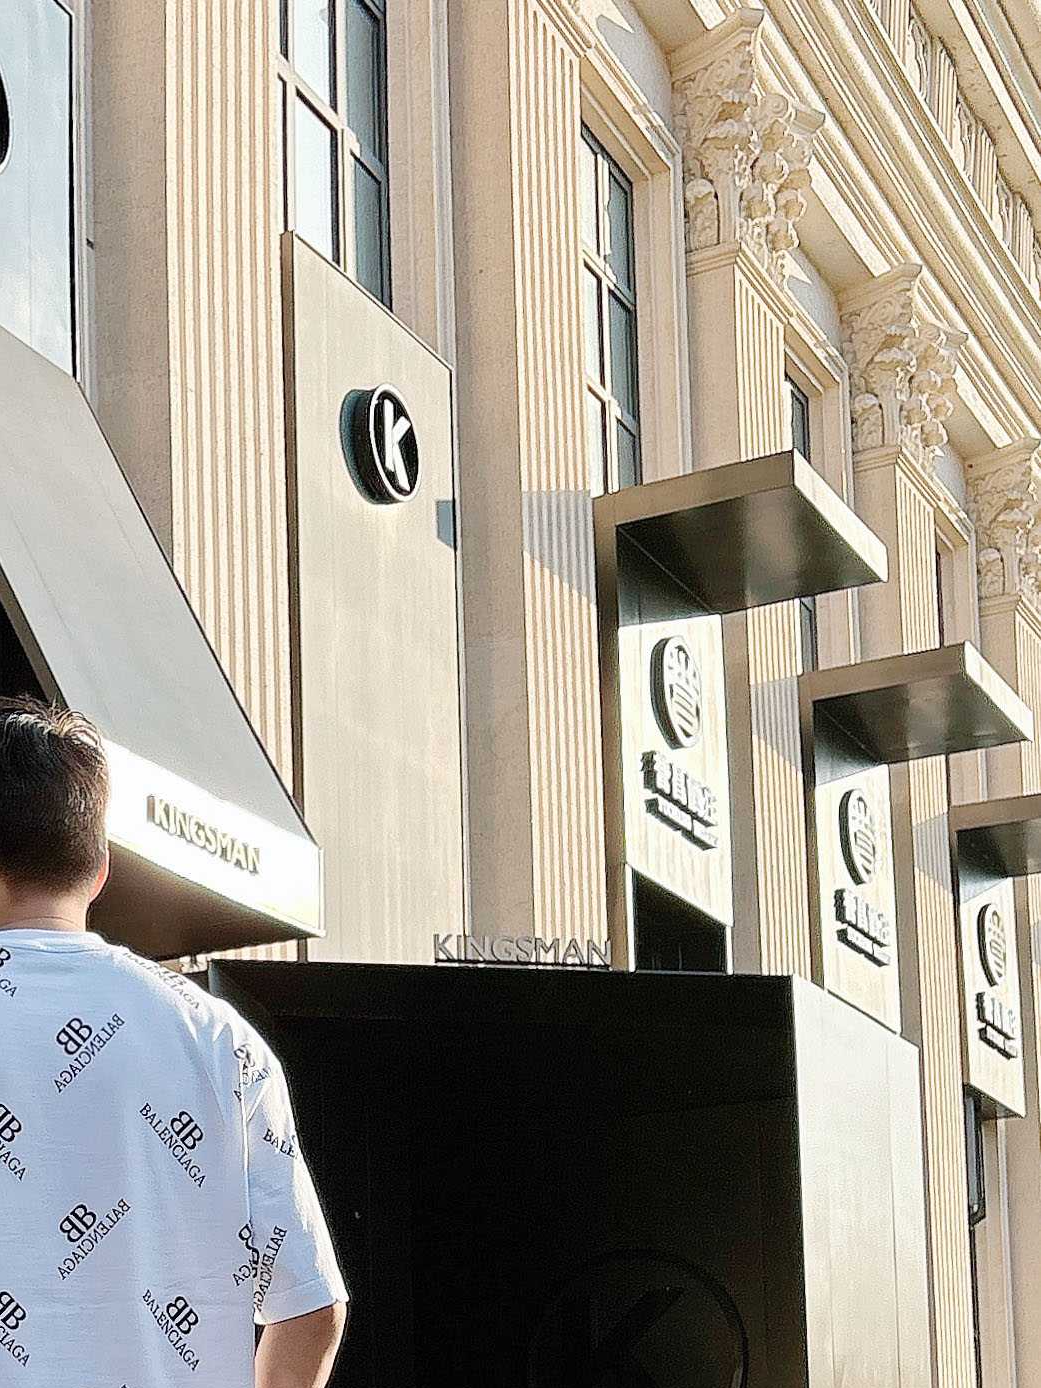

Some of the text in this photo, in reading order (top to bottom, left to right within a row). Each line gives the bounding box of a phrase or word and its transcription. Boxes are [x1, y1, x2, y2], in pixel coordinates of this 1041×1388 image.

[151, 797, 260, 875] KINGSMAN
[433, 934, 611, 967] KINGSMAN
[139, 1103, 207, 1188] BALENCIAGA
[142, 1289, 200, 1371] BALENCIAGA
